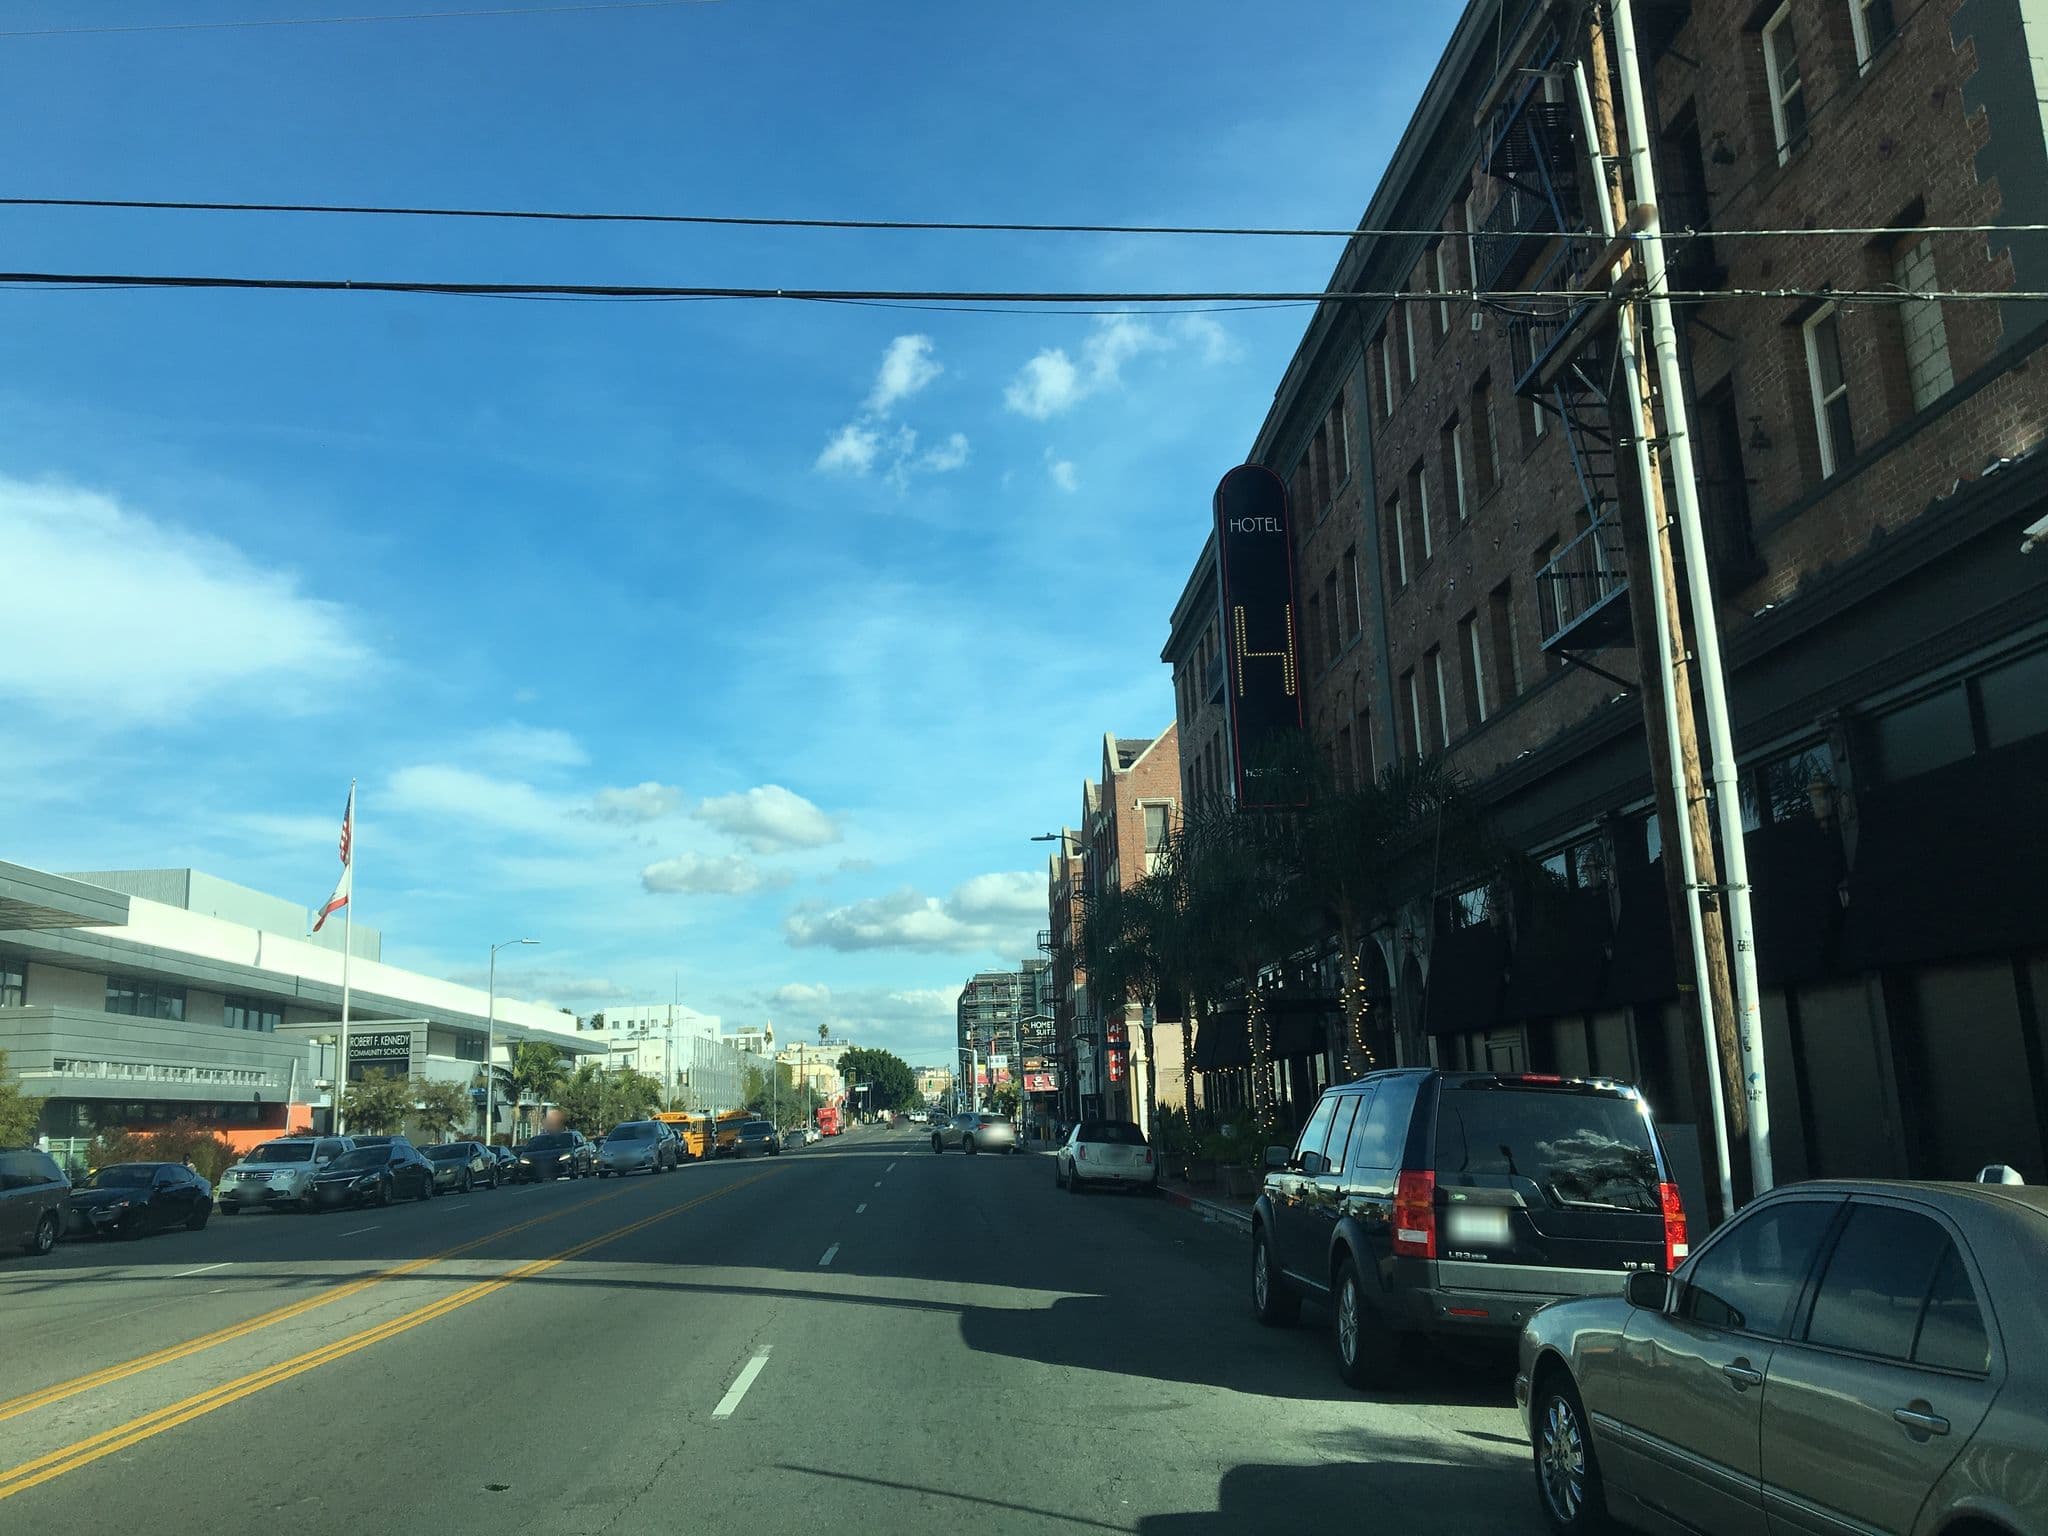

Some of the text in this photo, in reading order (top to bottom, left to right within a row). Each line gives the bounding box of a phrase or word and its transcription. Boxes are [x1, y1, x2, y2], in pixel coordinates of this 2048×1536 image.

[1230, 517, 1283, 533] HOTEL
[1234, 604, 1296, 696] H
[350, 1034, 410, 1047] ROBERT F. KENNEDY
[350, 1047, 409, 1057] COMMUNITY SCHOOLS
[1448, 1250, 1471, 1260] LR3
